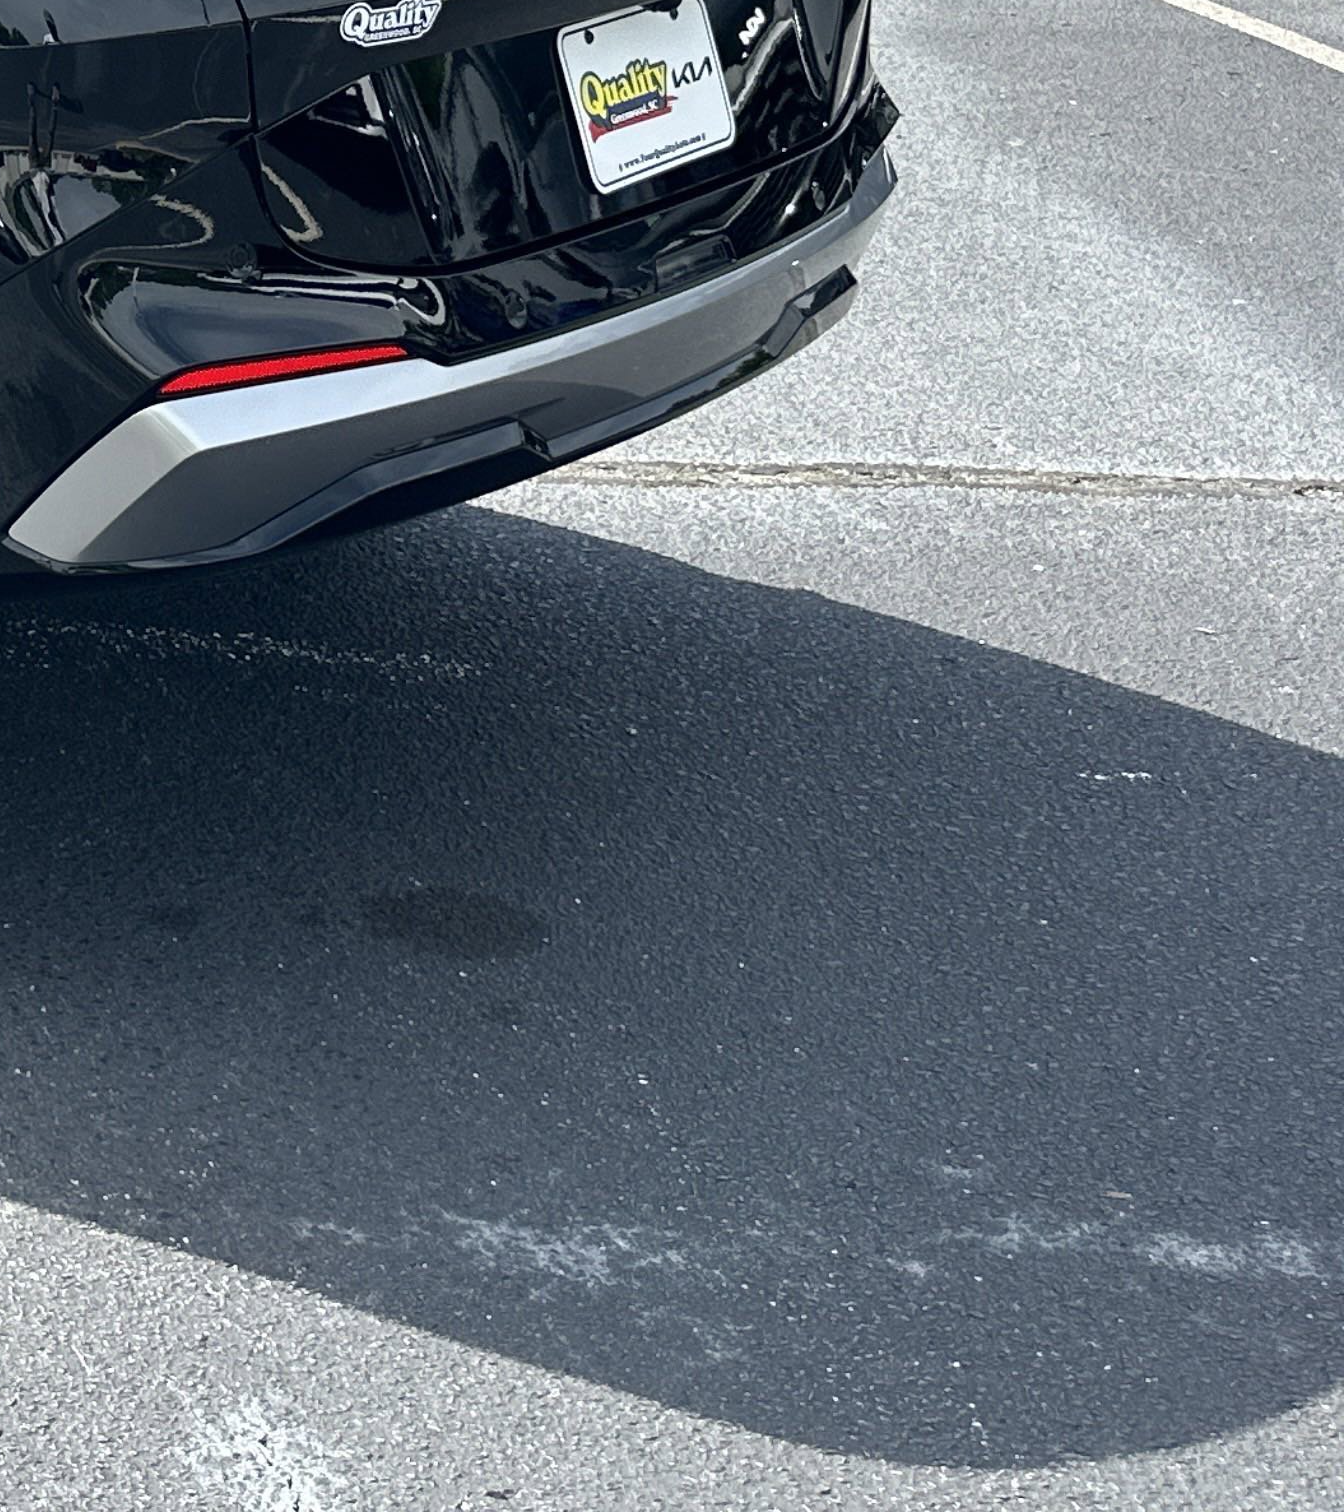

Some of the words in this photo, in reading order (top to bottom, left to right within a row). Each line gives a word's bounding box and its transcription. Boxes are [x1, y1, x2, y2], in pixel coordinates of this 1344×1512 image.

[344, 2, 438, 39] Quality
[581, 59, 666, 119] Quality
[672, 56, 712, 88] KIA
